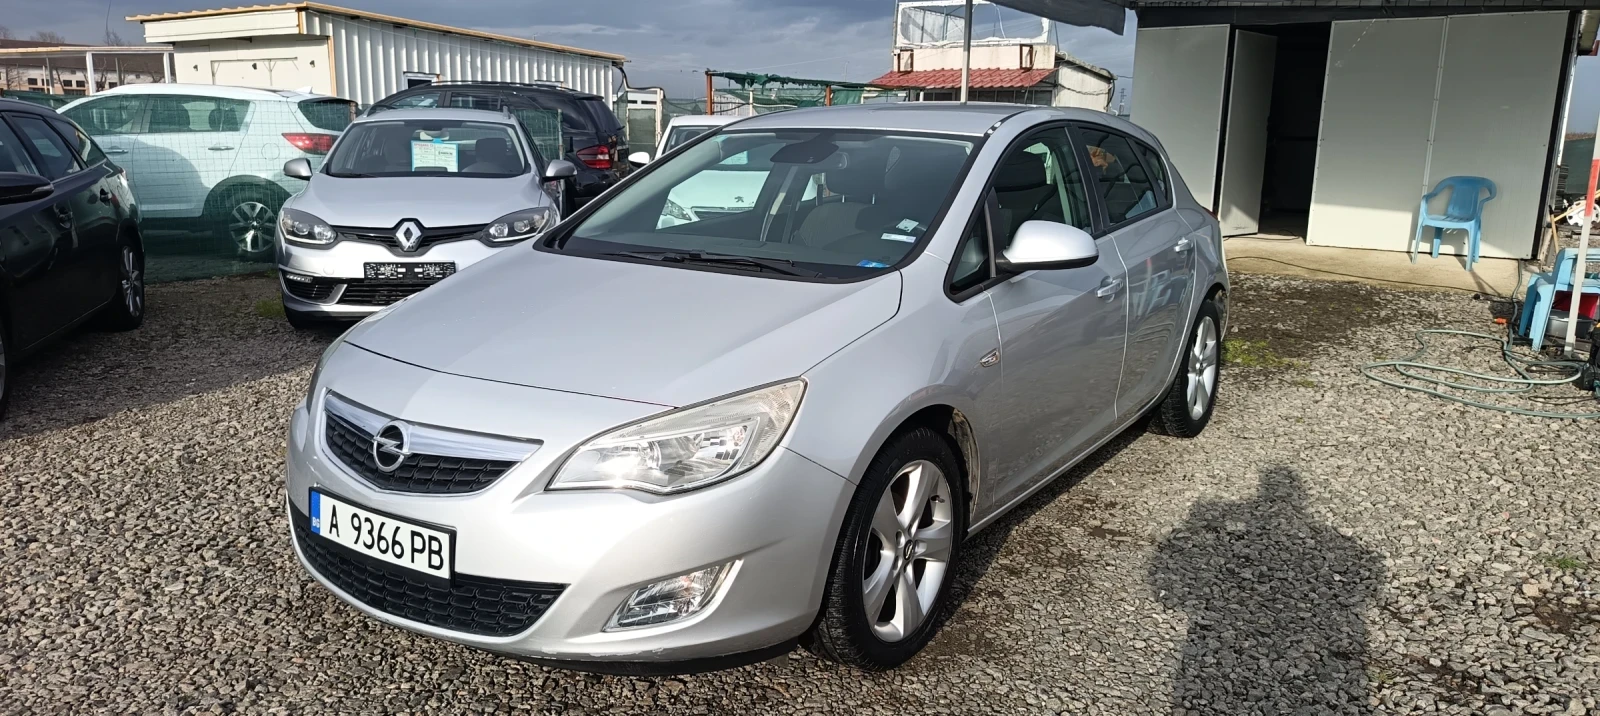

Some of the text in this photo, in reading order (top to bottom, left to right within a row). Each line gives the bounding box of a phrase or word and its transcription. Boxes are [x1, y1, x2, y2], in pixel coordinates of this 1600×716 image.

[312, 517, 320, 528] BG
[329, 504, 340, 538] A
[351, 512, 405, 559] 9366
